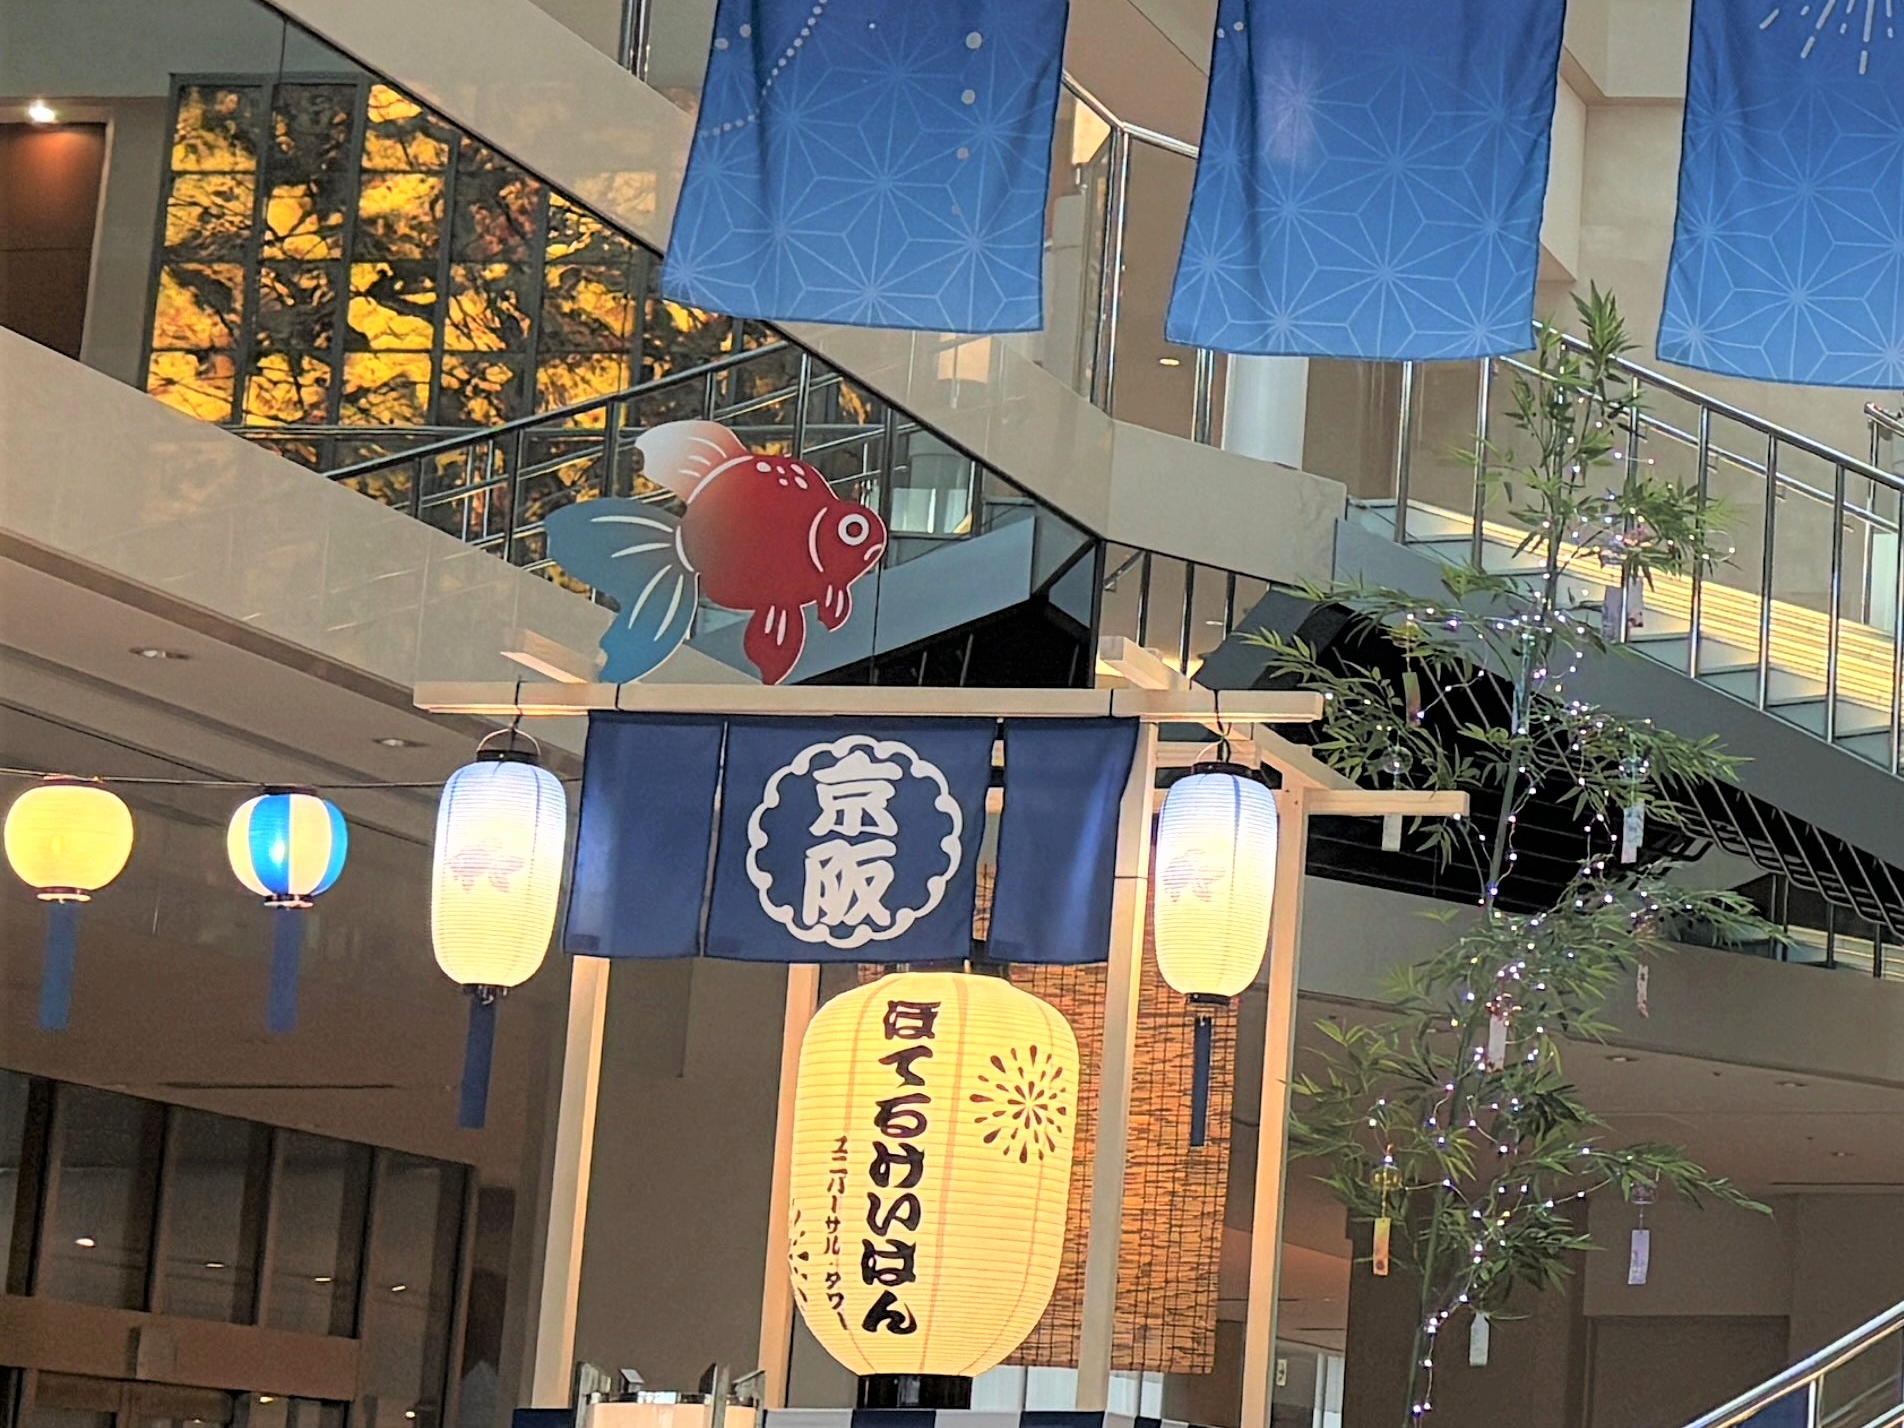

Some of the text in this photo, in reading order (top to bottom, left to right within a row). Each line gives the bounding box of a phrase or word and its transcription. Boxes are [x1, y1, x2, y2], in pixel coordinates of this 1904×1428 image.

[804, 755, 904, 931] 京阪
[861, 1000, 942, 1335] ほてるけいはん
